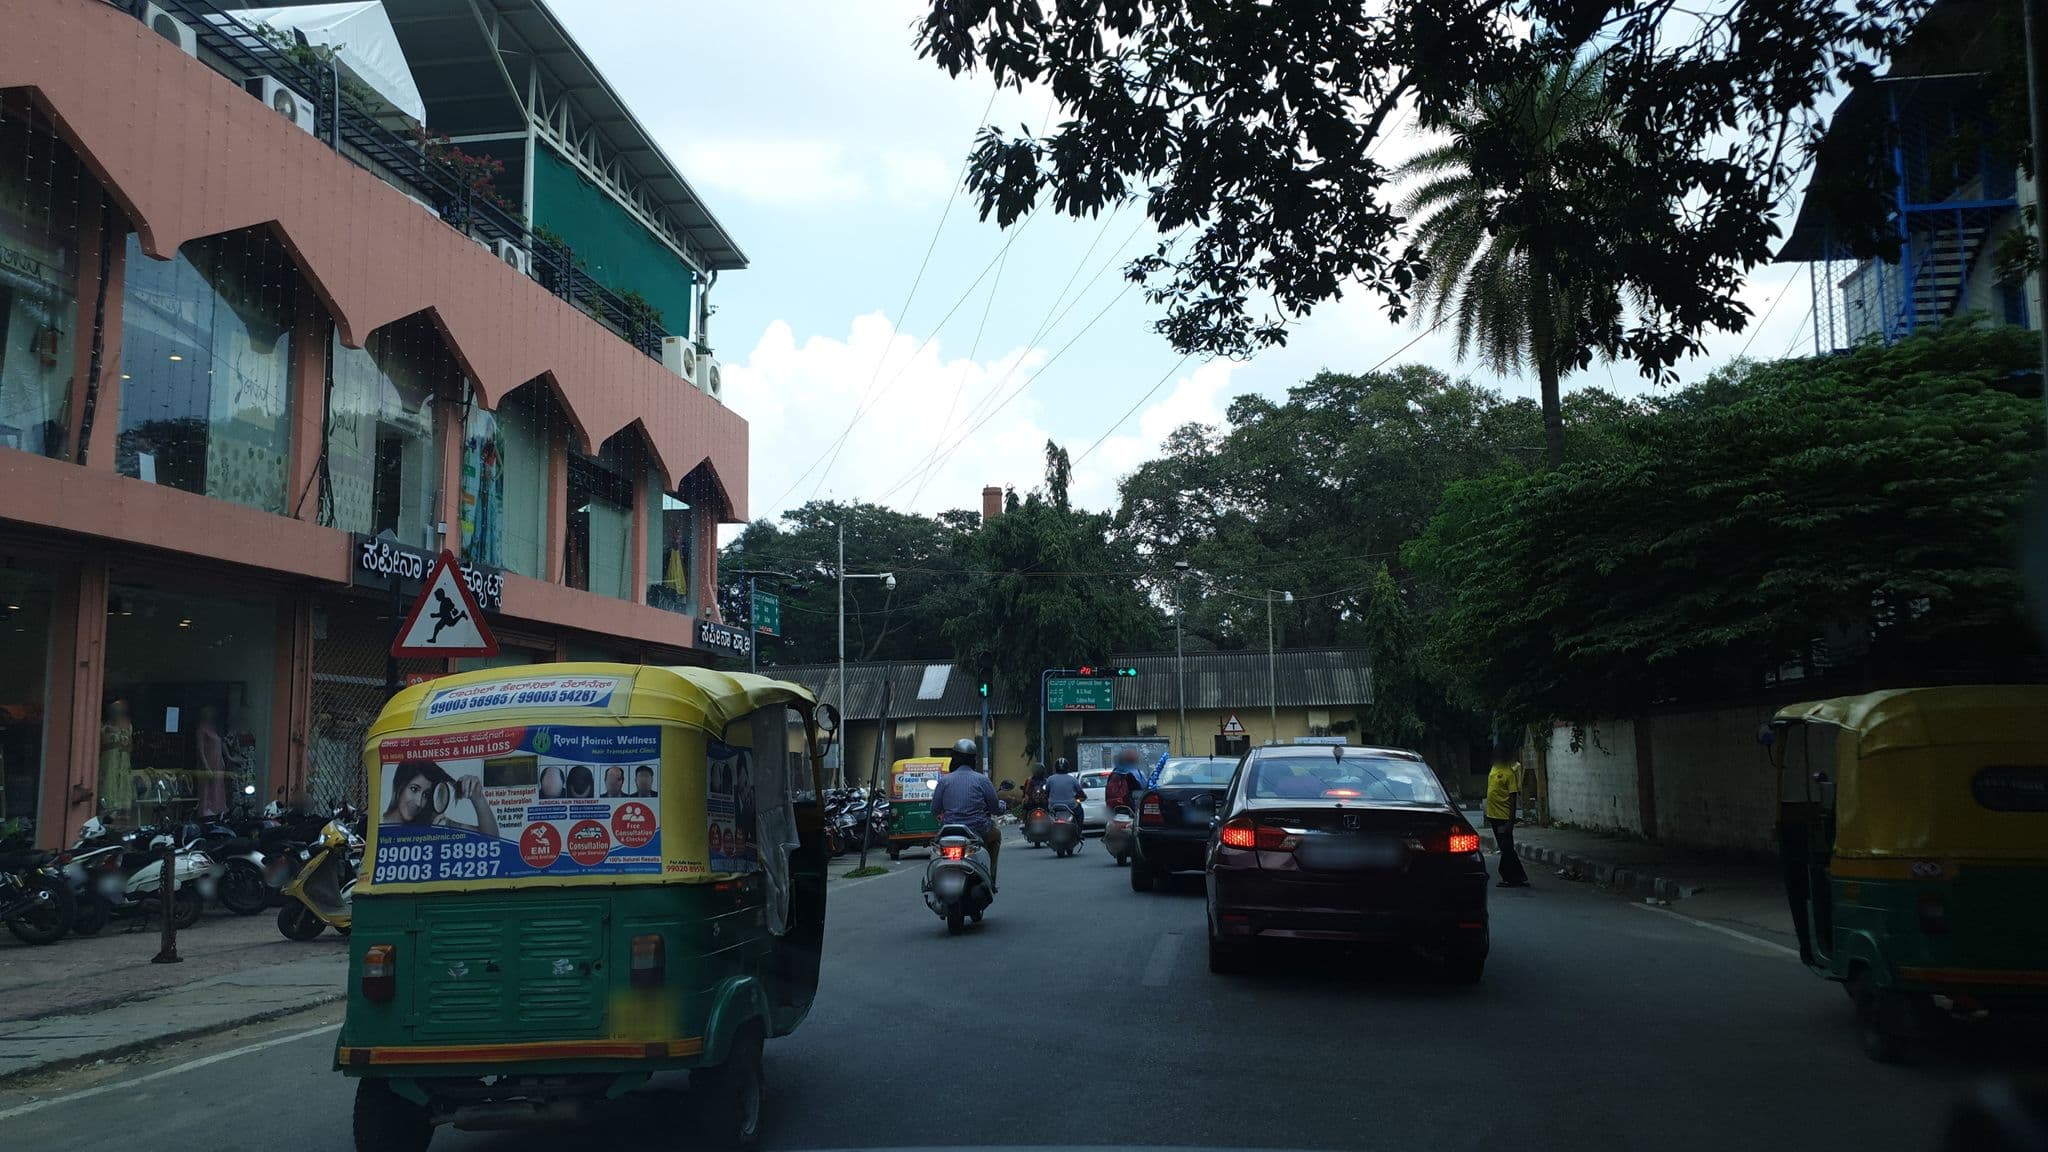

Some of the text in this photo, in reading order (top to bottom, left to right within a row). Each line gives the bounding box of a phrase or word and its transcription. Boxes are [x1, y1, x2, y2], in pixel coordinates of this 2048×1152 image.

[363, 538, 422, 579] ಸಫೀನಾ
[430, 698, 467, 715] 99003
[518, 690, 557, 703] 99003
[553, 734, 657, 748] Royal Hairnic Wellness
[407, 747, 450, 759] BALDNESS
[453, 747, 459, 755] &
[463, 744, 485, 754] HAIR
[488, 741, 511, 751] LOSS
[508, 788, 536, 796] Transplant
[502, 797, 532, 805] Restoration
[397, 833, 467, 843] www.royalhairnic.com
[378, 842, 501, 863] 99003 58985
[531, 846, 551, 855] EMI
[569, 842, 609, 852] Consultation
[375, 861, 501, 883] 99003 54287
